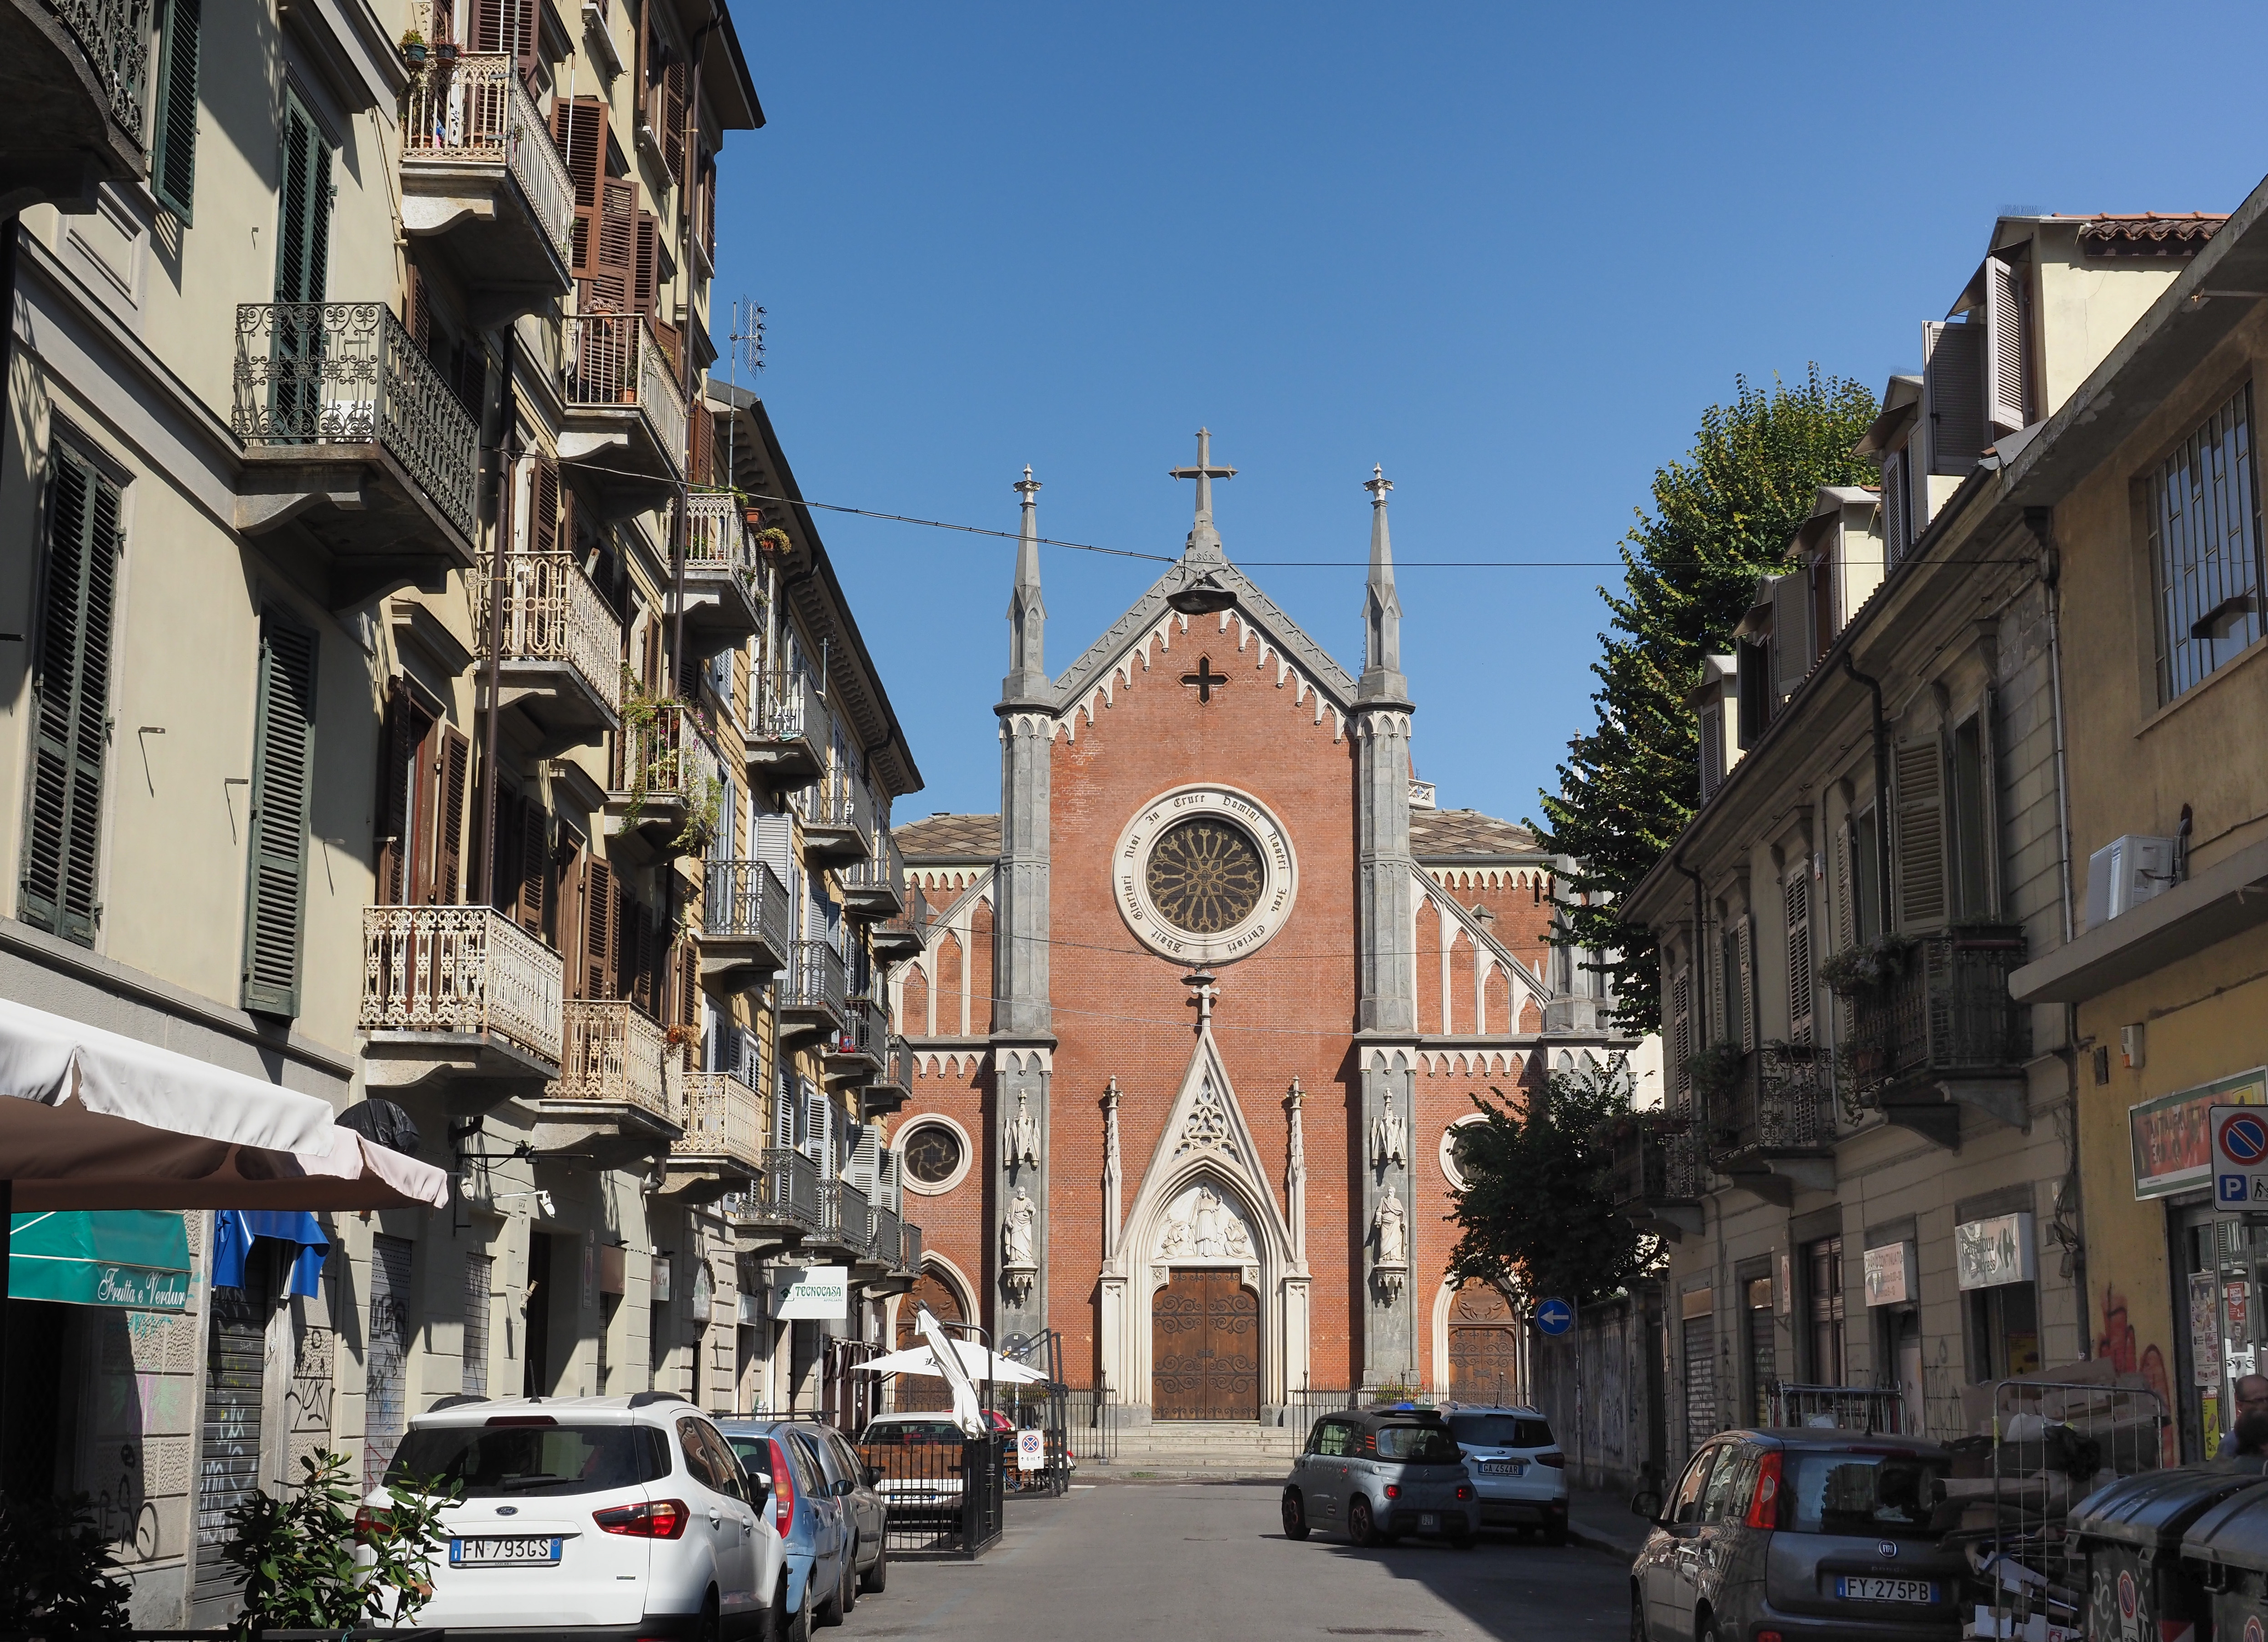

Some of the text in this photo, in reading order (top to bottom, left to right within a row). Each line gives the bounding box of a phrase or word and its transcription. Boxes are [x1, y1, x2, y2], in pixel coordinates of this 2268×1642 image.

[1222, 795, 1262, 823] Domini
[1124, 834, 1141, 859] Nisi
[1267, 831, 1289, 870] Nostri
[1227, 925, 1265, 954] Christi
[2226, 1178, 2241, 1198] P
[97, 1268, 186, 1305] Frutta e Verdur
[795, 1286, 842, 1297] TECNOCASA
[463, 1539, 485, 1559] FN
[492, 1539, 549, 1558] 793GS
[1883, 1544, 1893, 1553] FIAT
[1848, 1578, 1868, 1596] FY
[1875, 1580, 1929, 1600] 275PB
